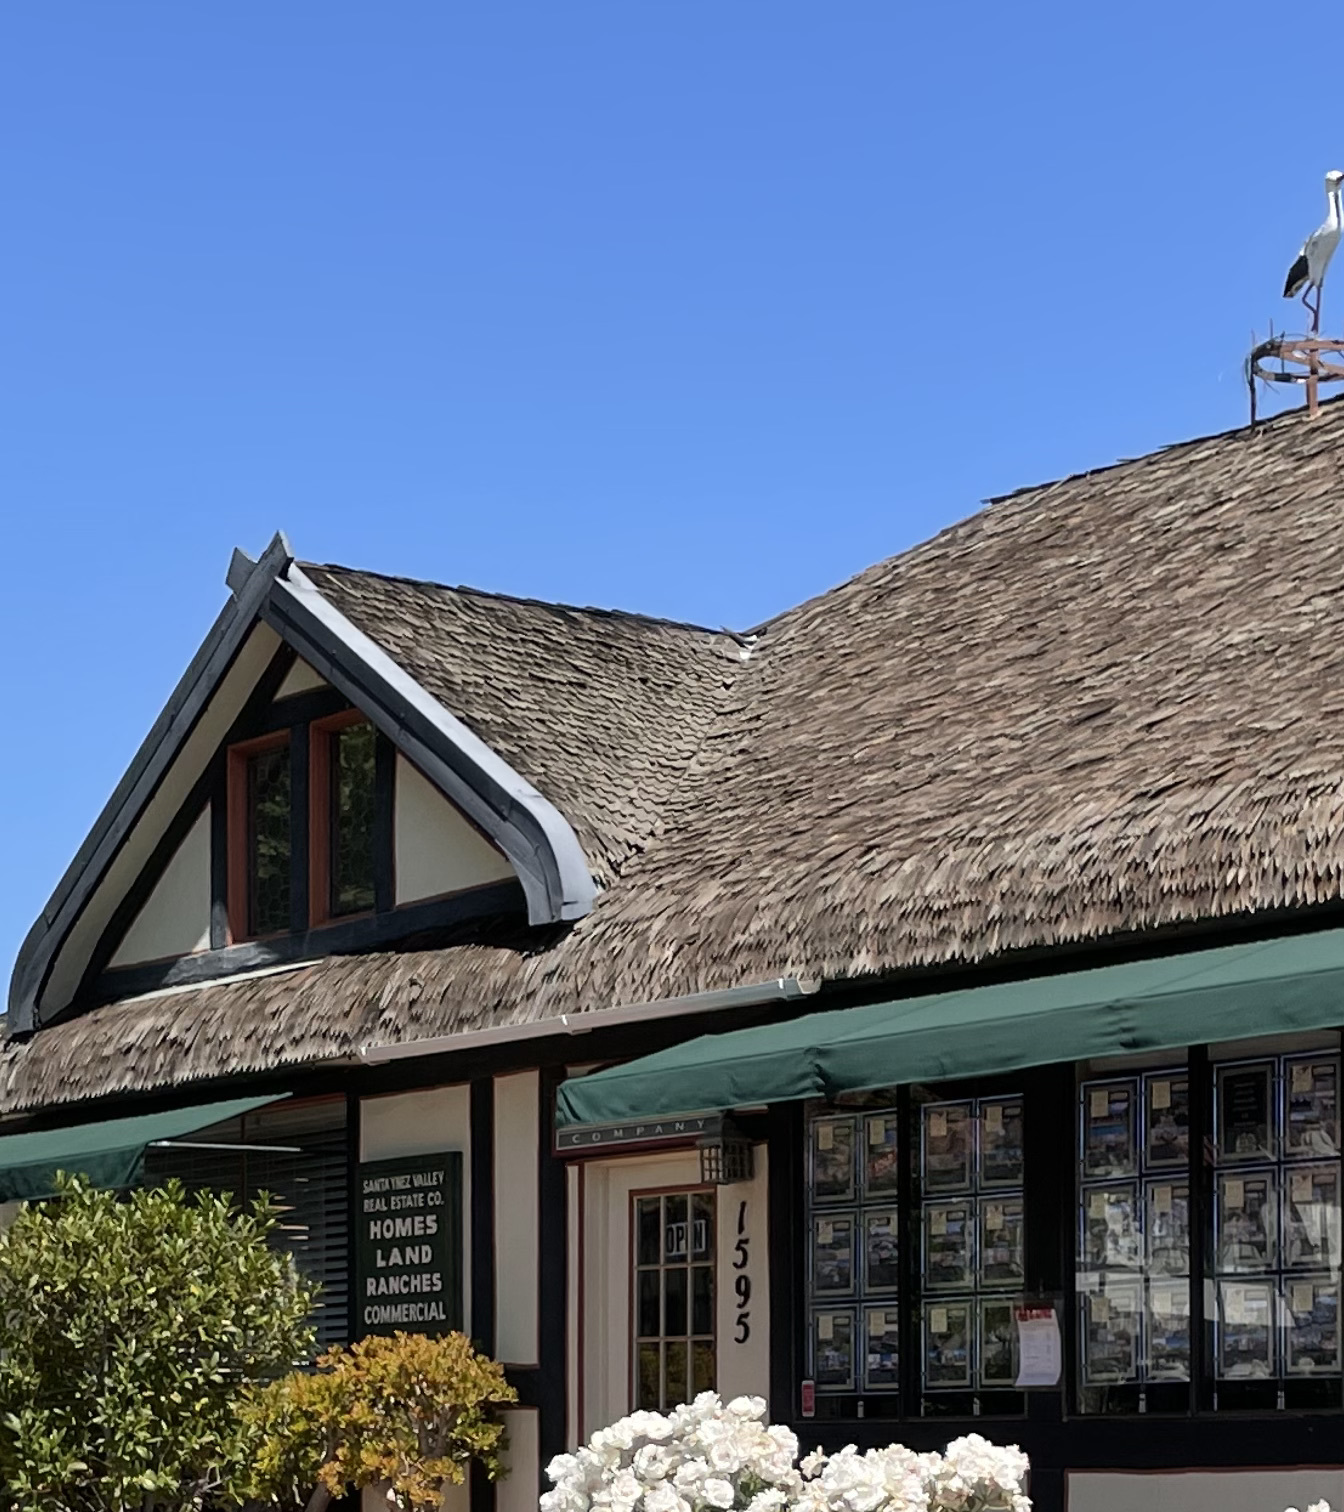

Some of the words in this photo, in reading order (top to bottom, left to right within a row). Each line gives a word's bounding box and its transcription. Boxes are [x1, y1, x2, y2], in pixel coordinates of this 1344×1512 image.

[572, 1120, 704, 1143] COMPANY
[412, 1170, 445, 1188] VALLEY
[363, 1197, 388, 1213] REAL
[390, 1193, 425, 1210] ESTATE
[427, 1191, 445, 1207] CO.
[369, 1214, 439, 1240] HOMES
[666, 1222, 702, 1253] OPN
[376, 1245, 433, 1268] LAND
[366, 1272, 443, 1297] RANCHES
[732, 1201, 751, 1344] 1595
[364, 1300, 446, 1325] COMMERCIAL
